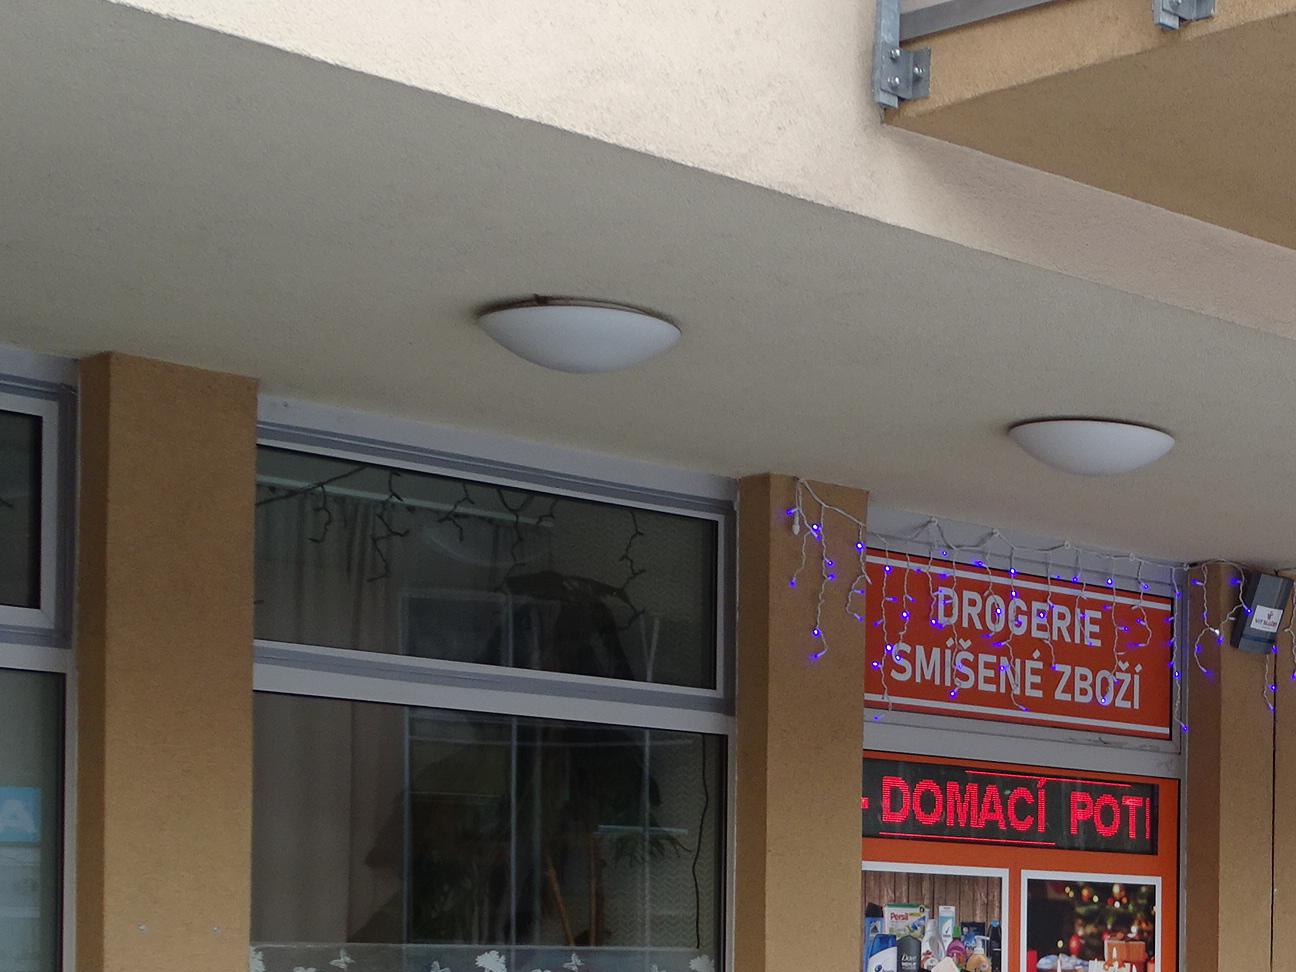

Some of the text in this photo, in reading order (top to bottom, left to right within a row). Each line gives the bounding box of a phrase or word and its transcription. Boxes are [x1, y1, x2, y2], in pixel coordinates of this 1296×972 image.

[937, 588, 1102, 648] DROGERIE
[890, 637, 1142, 710] SMÍŠENÉ ZBOŽÍ
[881, 775, 1151, 840] DOMACÍ POT
